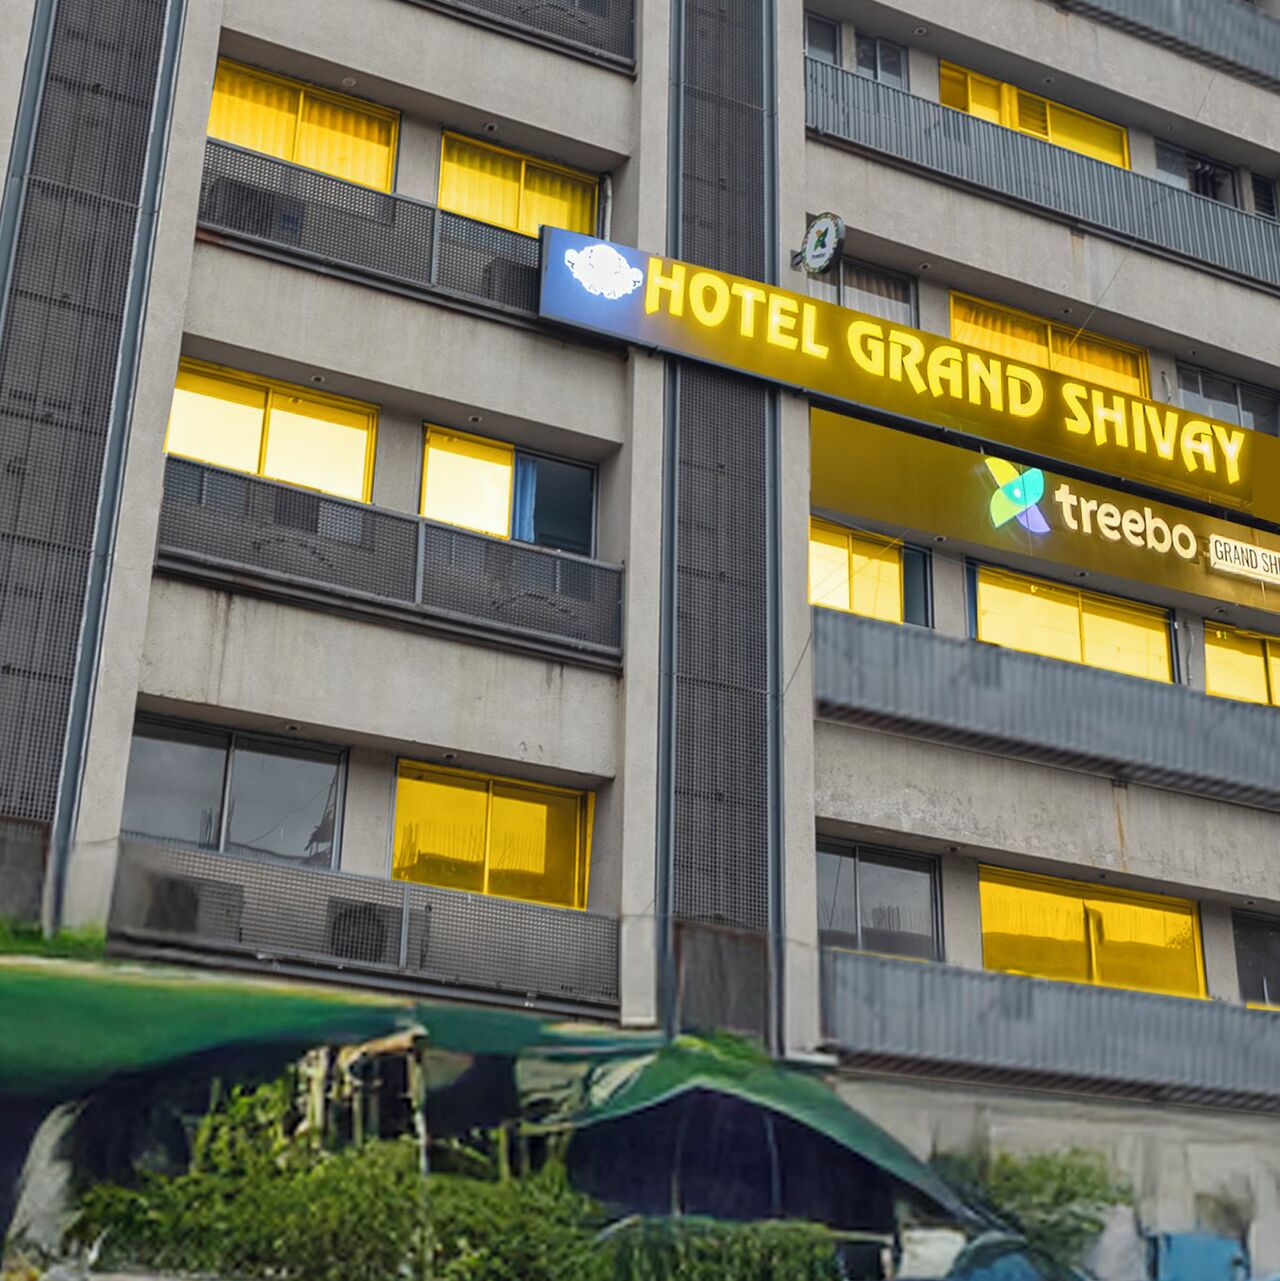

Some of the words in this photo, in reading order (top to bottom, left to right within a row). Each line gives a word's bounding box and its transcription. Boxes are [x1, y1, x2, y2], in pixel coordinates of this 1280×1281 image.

[645, 257, 829, 359] HOTEL
[847, 320, 1044, 417] GRAND
[1063, 382, 1245, 484] SHIVAY
[1055, 484, 1197, 559] treebo
[1214, 539, 1258, 569] GRAND
